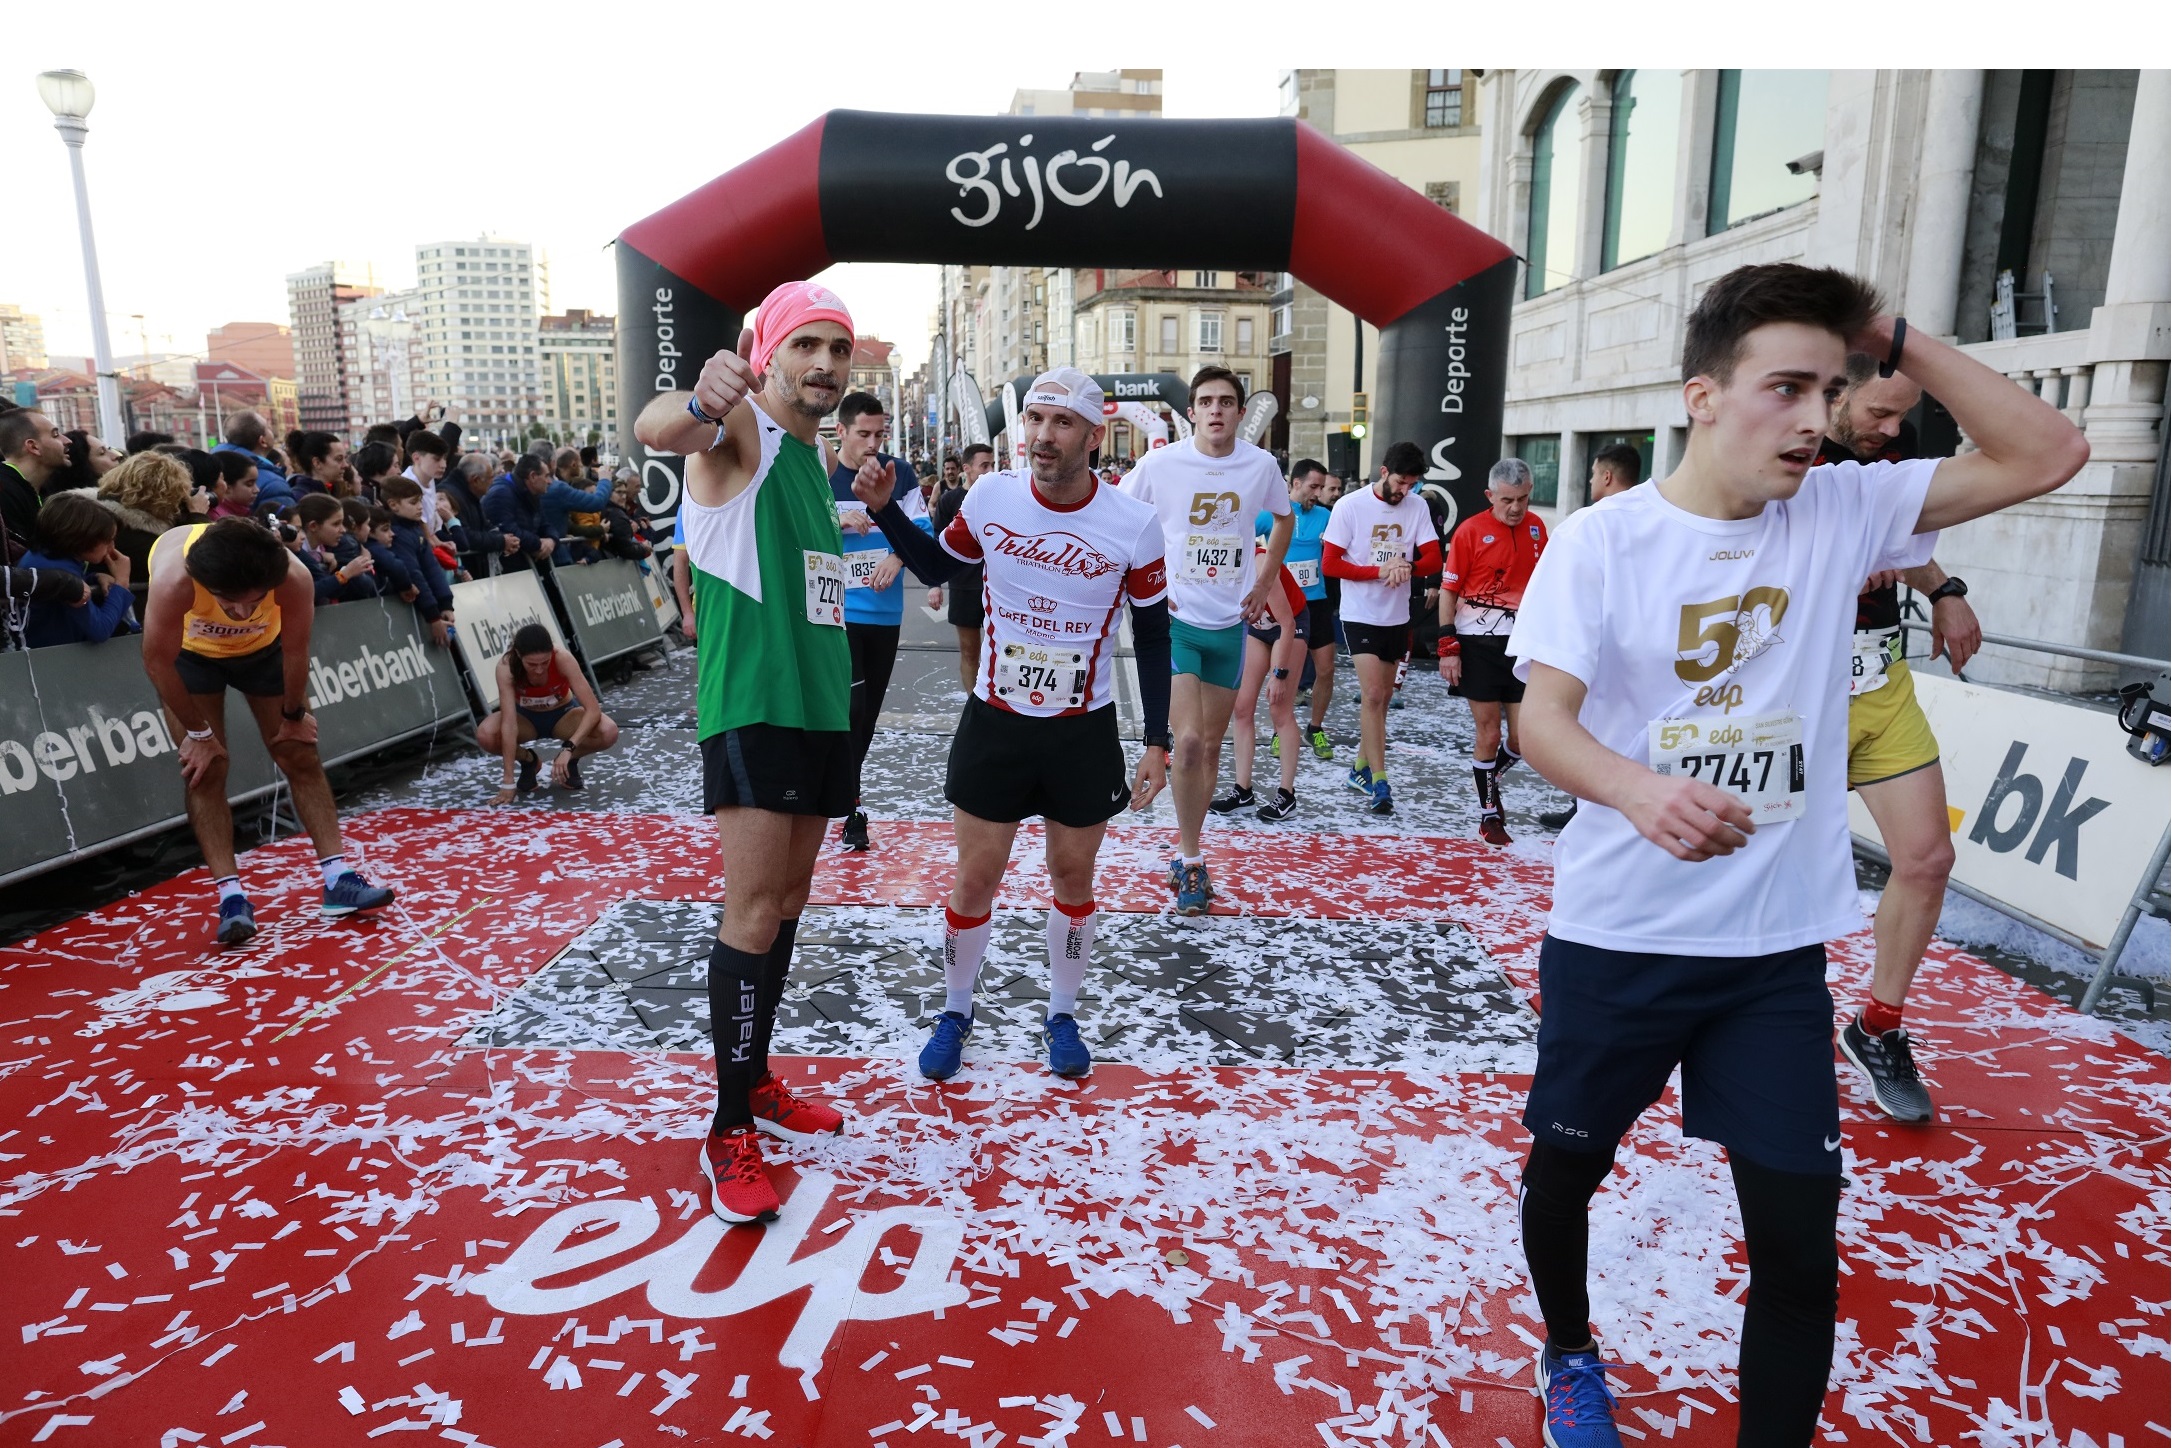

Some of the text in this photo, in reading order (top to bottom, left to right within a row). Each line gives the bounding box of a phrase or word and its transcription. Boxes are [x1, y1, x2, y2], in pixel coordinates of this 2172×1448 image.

[946, 134, 1163, 230] gijón
[652, 287, 682, 392] Deporte
[1441, 307, 1471, 413] Deporte
[1115, 379, 1160, 396] bank
[1243, 396, 1273, 442] rbank
[1188, 491, 1241, 527] 50
[984, 523, 1100, 579] Tribulls
[1016, 558, 1061, 574] TRIATHLON
[1197, 548, 1228, 566] 1432
[851, 561, 876, 577] 1835
[1298, 569, 1310, 580] 80
[578, 583, 643, 627] Liberbank
[1025, 628, 1056, 640] MADRID
[1032, 616, 1061, 632] DEL
[1065, 621, 1092, 634] REY
[1674, 586, 1789, 683] 50
[309, 633, 436, 710] iberbank
[1029, 650, 1048, 664] edp
[1018, 664, 1057, 692] 374
[1693, 679, 1744, 716] edp
[1660, 723, 1744, 750] 50 edp
[1681, 751, 1774, 793] 2747
[1968, 739, 2113, 882] bk
[1065, 926, 1077, 959] COMPRES
[1072, 936, 1083, 960] SPORT
[465, 1170, 972, 1370] edp
[1568, 1357, 1584, 1367] NIKE
